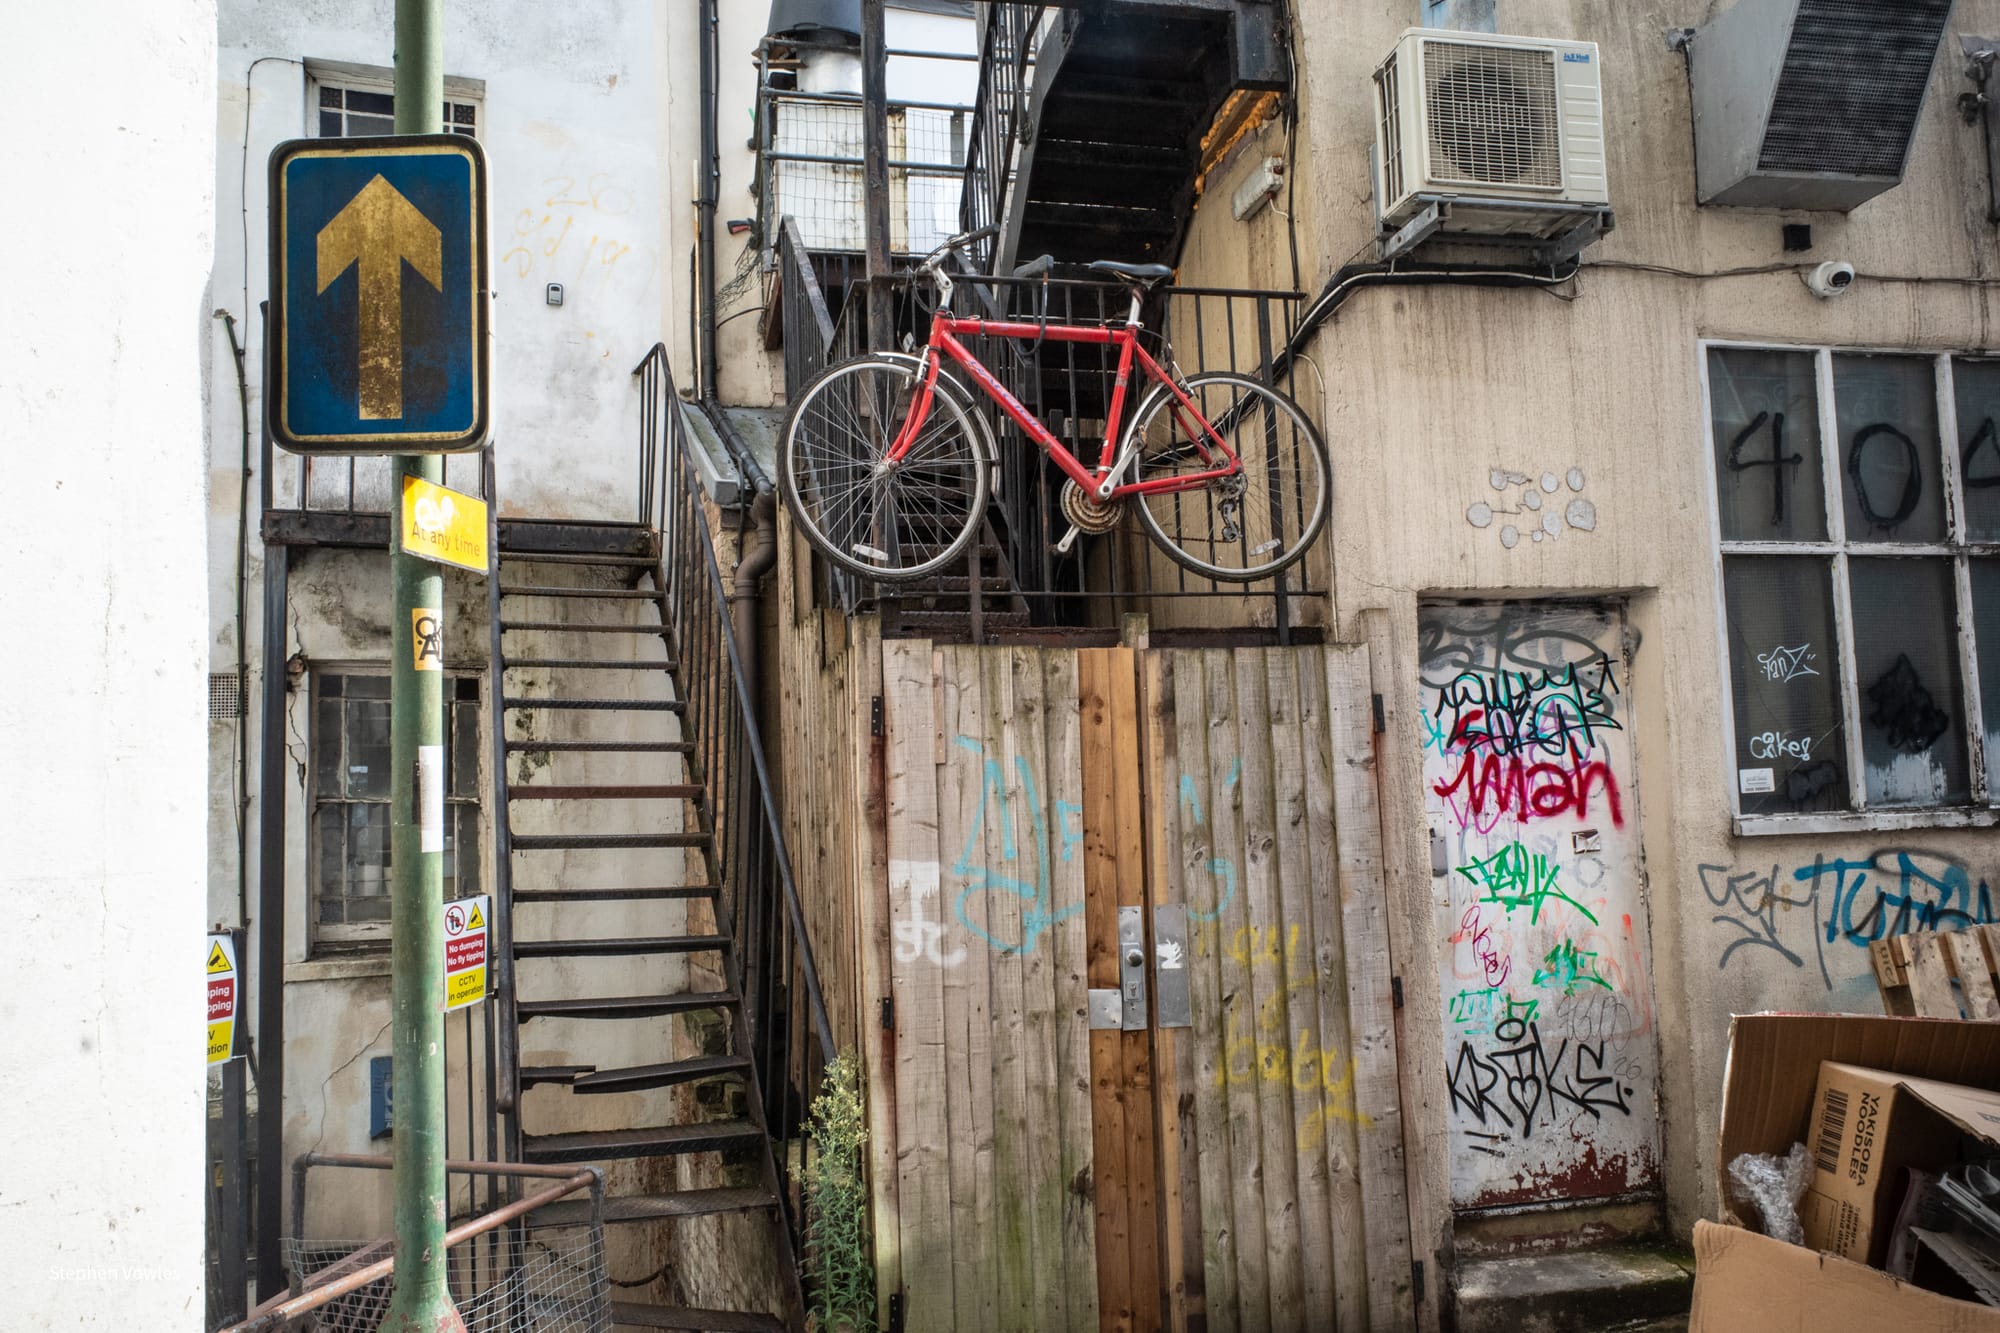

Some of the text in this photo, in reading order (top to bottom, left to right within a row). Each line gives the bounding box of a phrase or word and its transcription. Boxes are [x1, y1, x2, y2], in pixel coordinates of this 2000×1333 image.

[431, 530, 450, 552] any
[455, 533, 480, 557] time
[449, 939, 483, 953] No dumping
[448, 950, 484, 967] No fly tipping
[458, 974, 476, 987] CCTV
[207, 986, 230, 998] ping
[448, 984, 484, 1001] in operation
[1848, 1092, 1871, 1181] NOODLES
[1856, 1095, 1881, 1187] YAKISOBA
